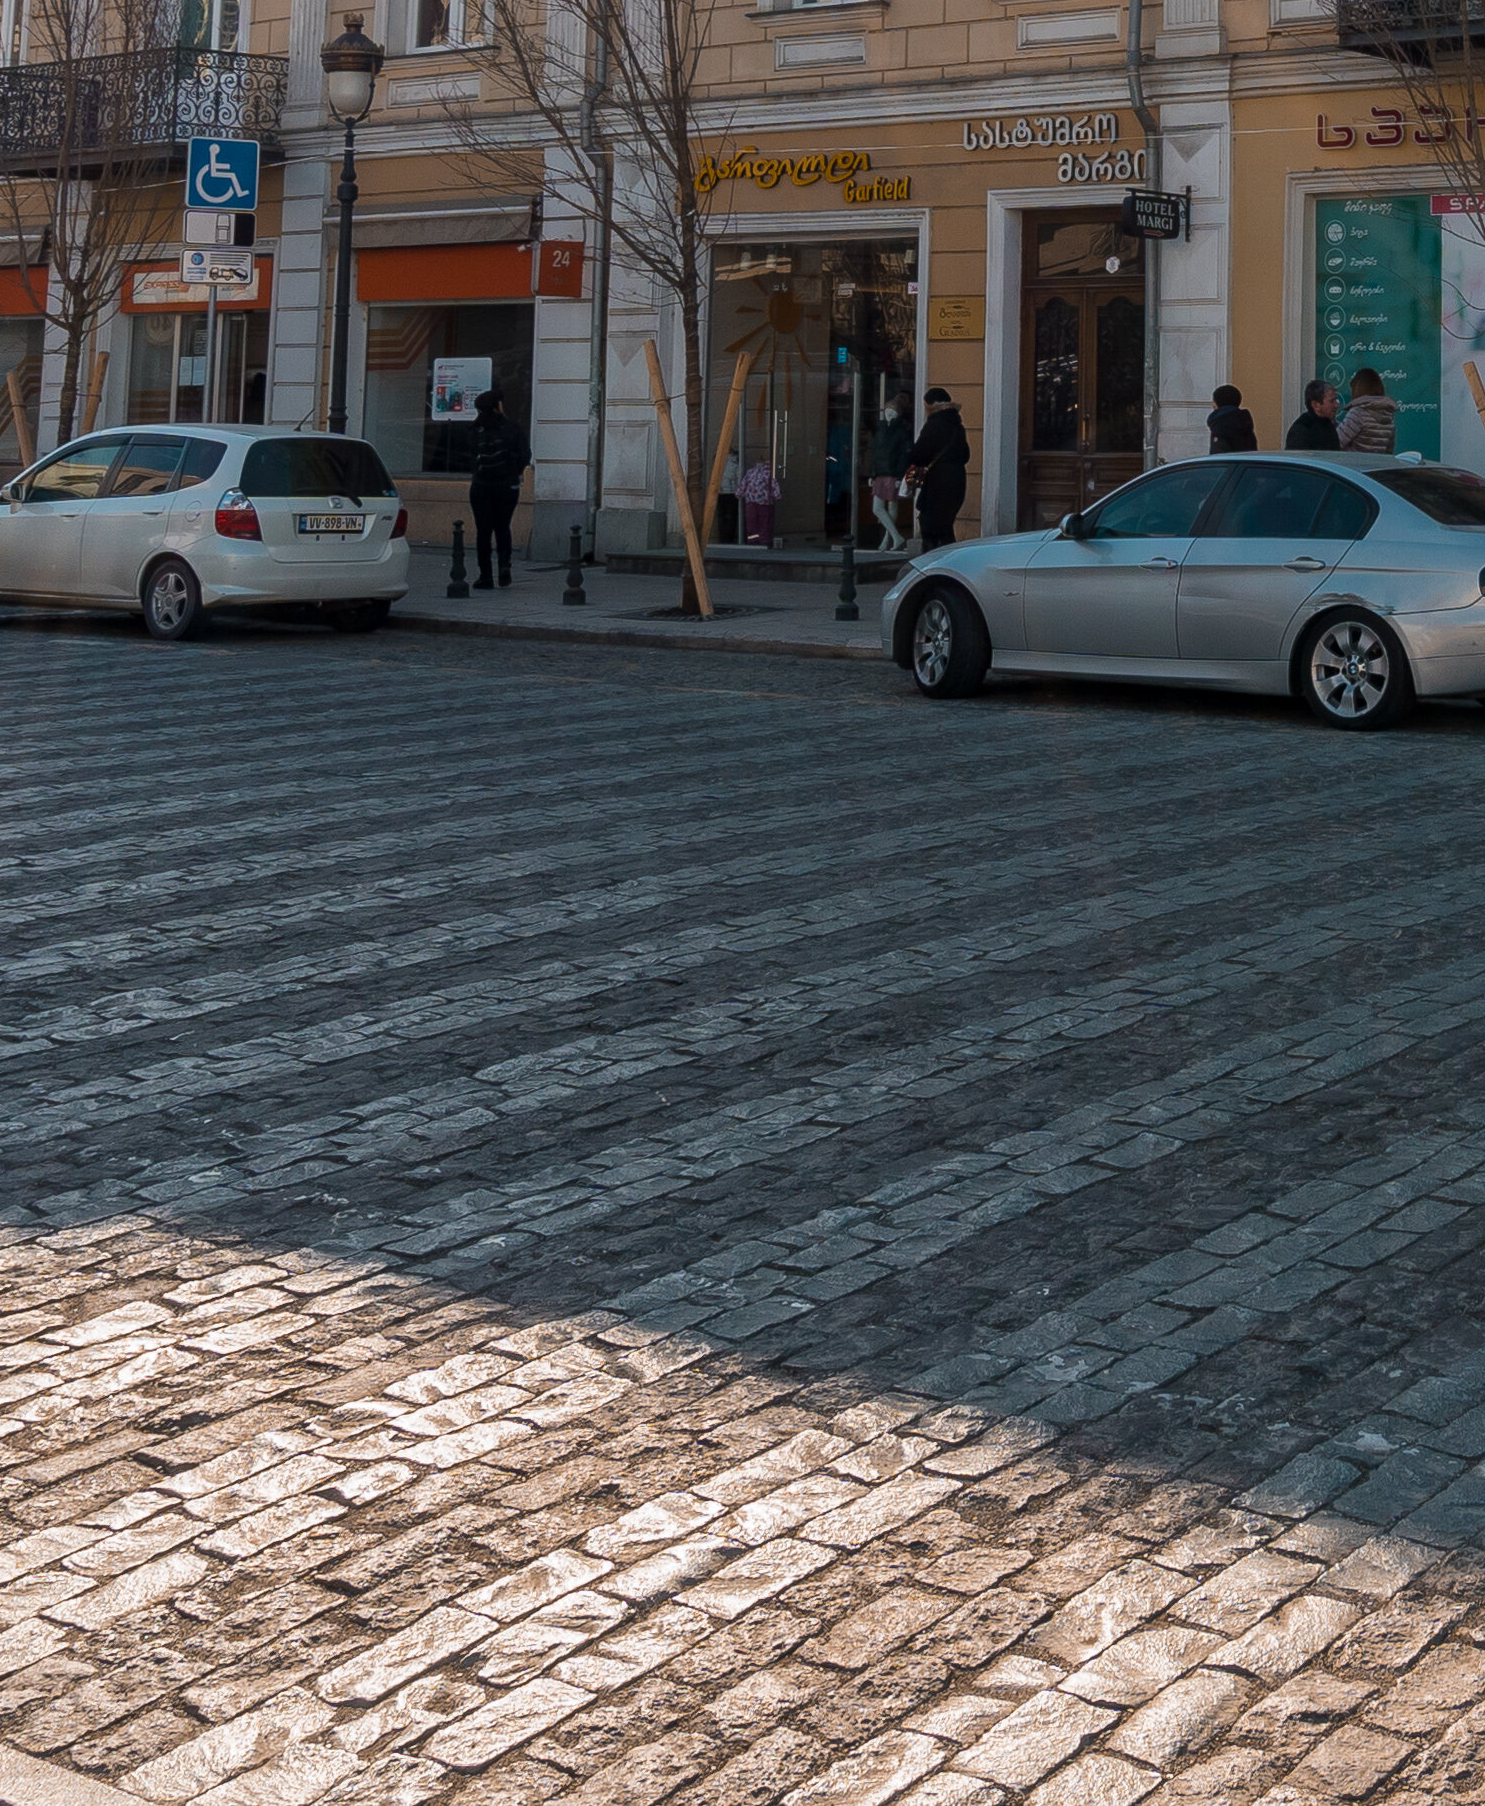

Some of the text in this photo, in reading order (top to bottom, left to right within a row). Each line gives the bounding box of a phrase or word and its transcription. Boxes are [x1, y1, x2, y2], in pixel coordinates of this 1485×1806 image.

[963, 112, 1118, 151] სასტუმრო
[844, 175, 913, 204] Garfield
[1135, 197, 1175, 217] HOTEL
[1136, 214, 1174, 232] MARGI
[552, 249, 571, 268] 24
